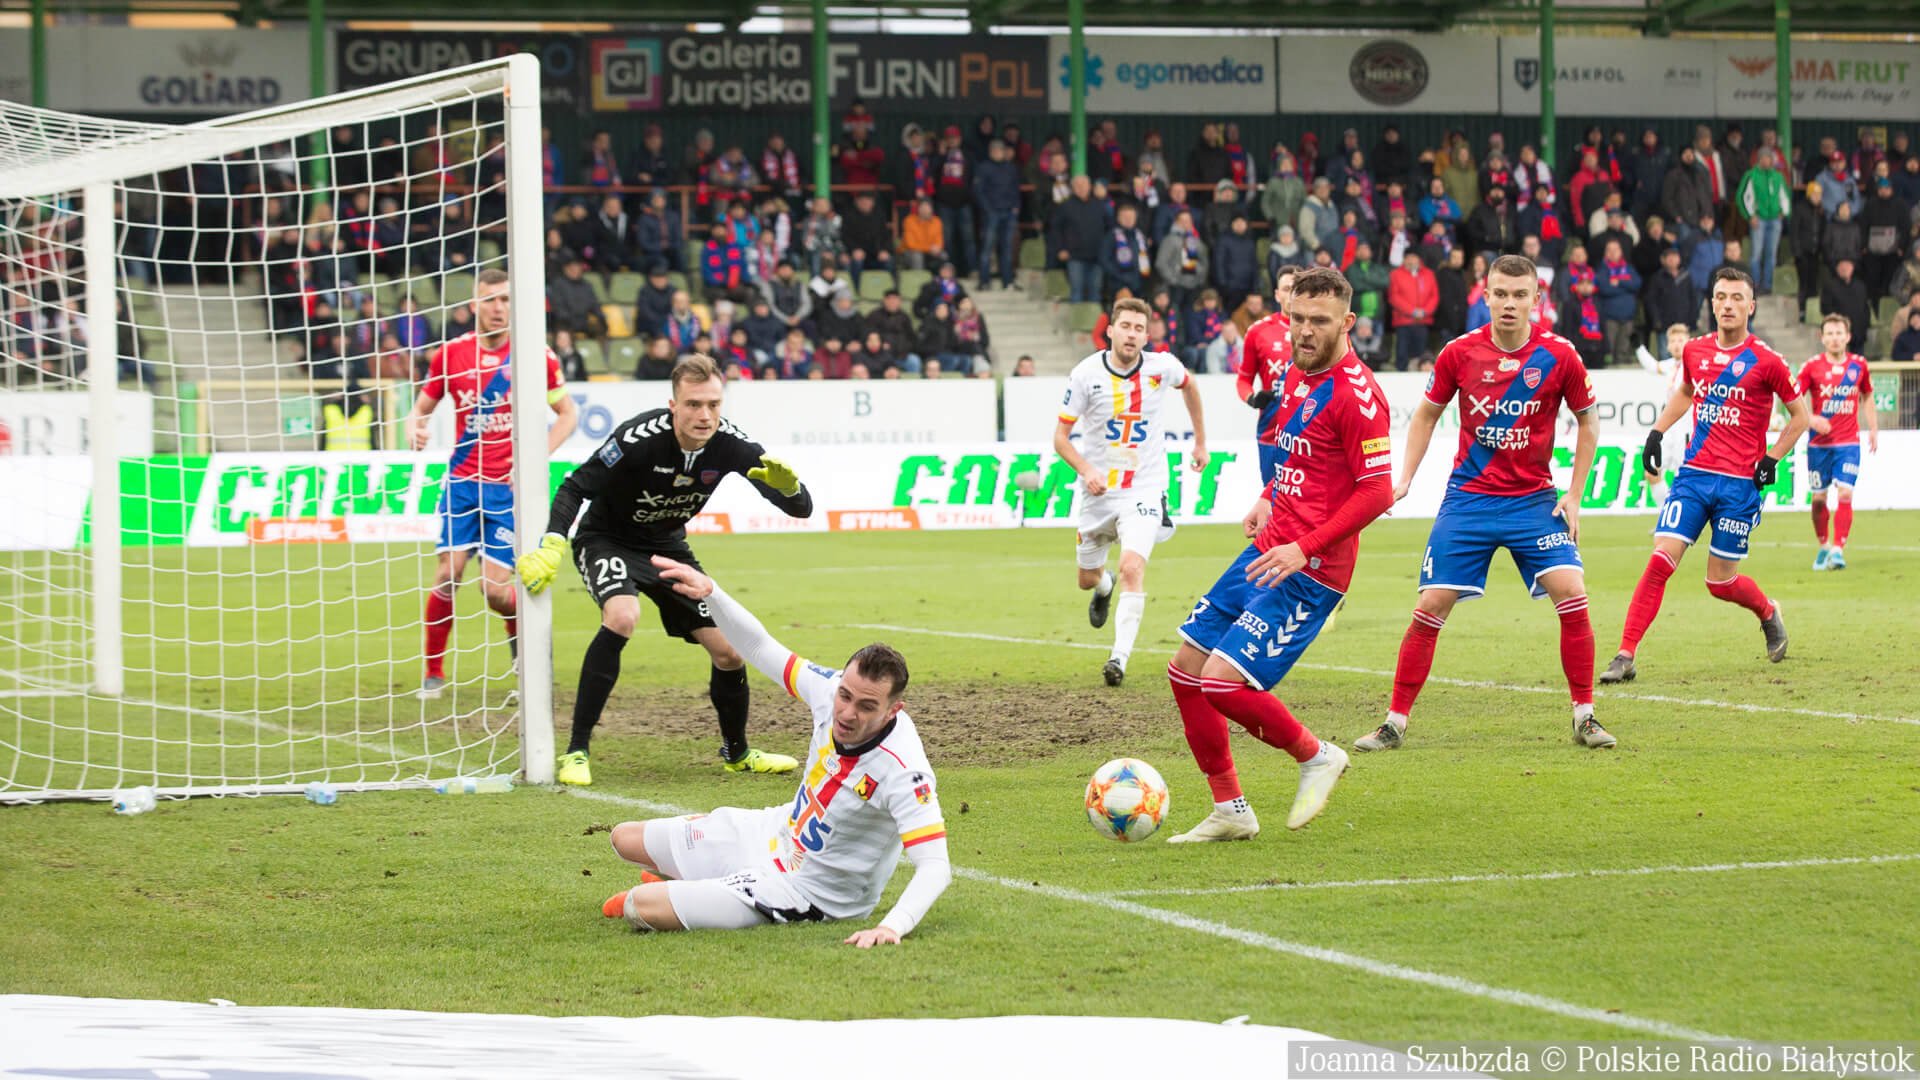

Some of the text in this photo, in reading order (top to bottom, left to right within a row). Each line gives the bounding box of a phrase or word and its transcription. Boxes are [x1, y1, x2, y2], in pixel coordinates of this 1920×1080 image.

[344, 39, 471, 75] GRUPA
[668, 37, 801, 69] Galeria
[1116, 56, 1264, 90] egomedica
[668, 74, 812, 110] Jurajska
[853, 391, 872, 417] B
[790, 429, 937, 446] BOULANGERIE
[1105, 413, 1149, 444] STS
[839, 511, 913, 530] STIHL
[935, 510, 994, 527] STIHL
[1661, 501, 1683, 529] 10
[595, 556, 628, 586] 29
[1422, 546, 1434, 579] 4
[788, 783, 833, 853] STS
